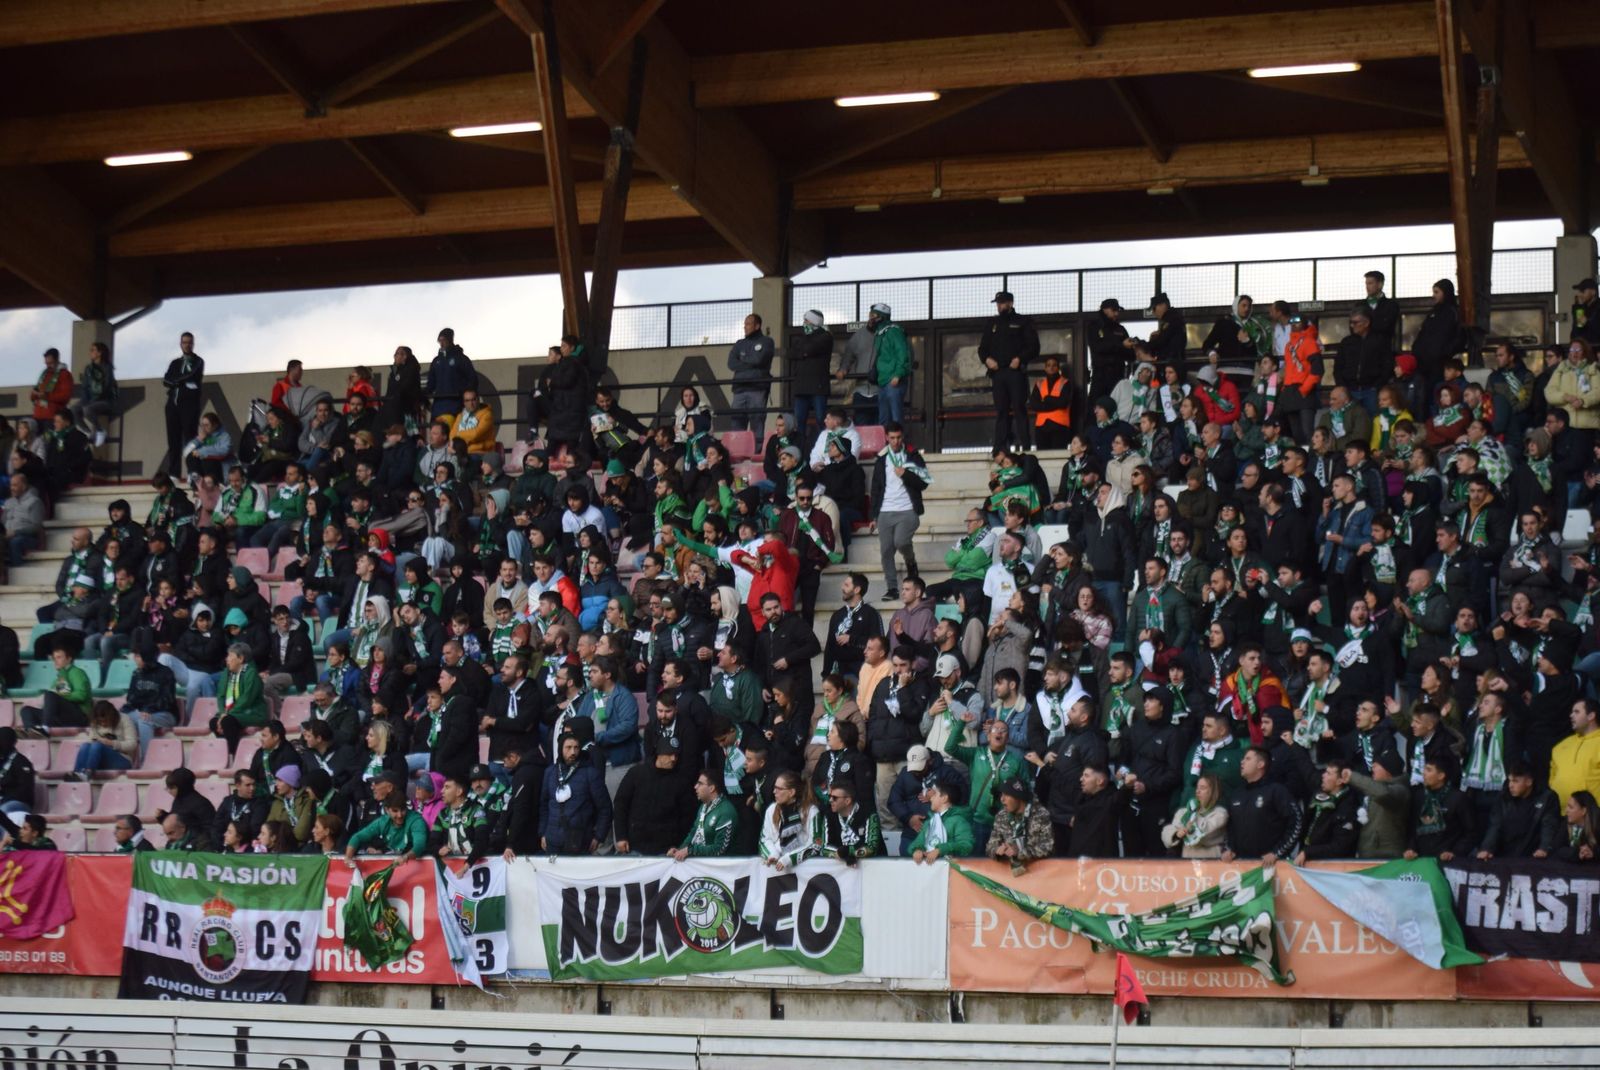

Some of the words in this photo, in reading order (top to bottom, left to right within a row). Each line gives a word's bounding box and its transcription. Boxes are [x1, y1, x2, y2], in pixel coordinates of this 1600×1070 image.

[151, 859, 198, 881] UNA
[206, 862, 297, 886] PASIÓN
[472, 866, 491, 898] 9
[1096, 868, 1178, 897] QUESO
[1444, 867, 1600, 935] TRAST
[475, 939, 496, 971] 3
[700, 937, 719, 948] 2014
[144, 975, 216, 999] AUNQUE
[1194, 970, 1269, 989] CRUDA
